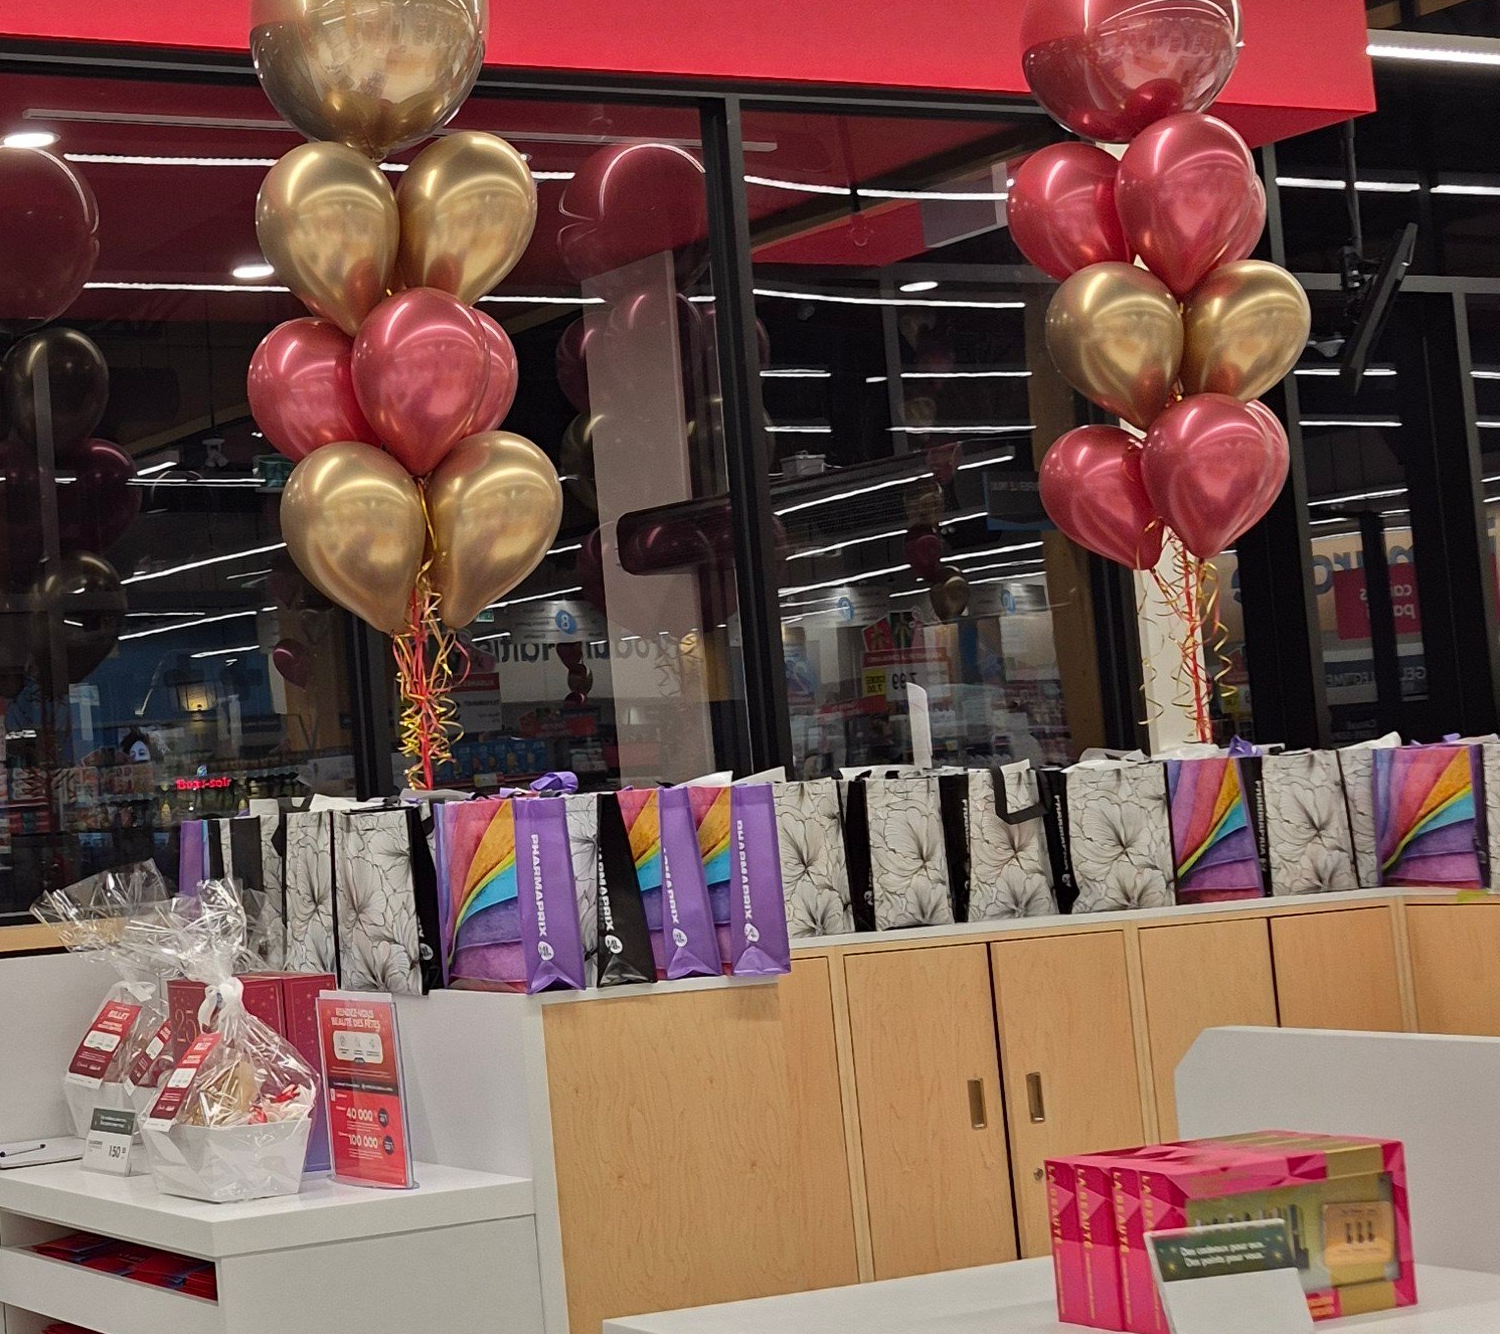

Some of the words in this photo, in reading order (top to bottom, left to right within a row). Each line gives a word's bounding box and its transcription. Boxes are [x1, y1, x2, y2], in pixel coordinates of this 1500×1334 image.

[531, 833, 547, 937] PHARMAPRIX
[736, 819, 753, 920] PHARMAPRIX
[357, 1109, 373, 1122] 000
[349, 1134, 362, 1146] 100
[363, 1136, 379, 1149] 000
[1144, 1198, 1155, 1231] BEA
